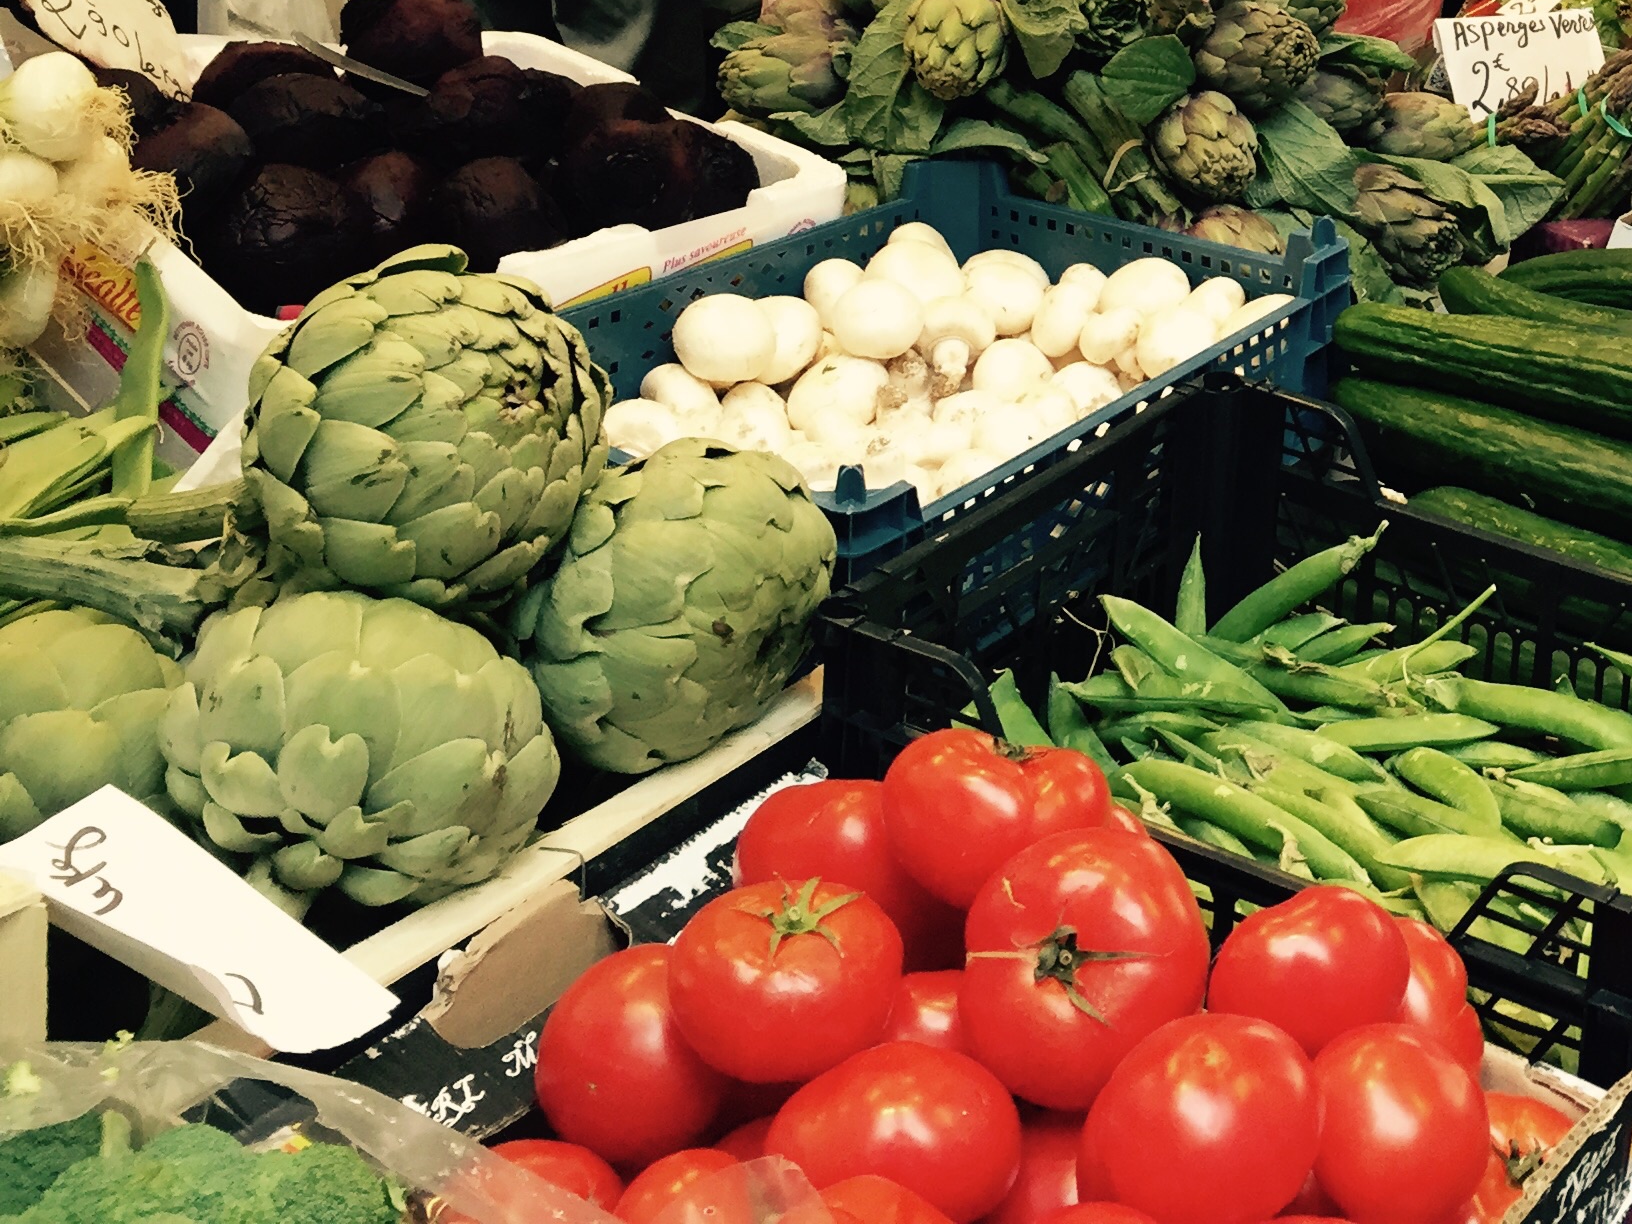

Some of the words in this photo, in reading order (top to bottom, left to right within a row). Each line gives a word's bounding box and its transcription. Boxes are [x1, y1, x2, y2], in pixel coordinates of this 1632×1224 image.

[1452, 18, 1547, 52] Asperges
[1549, 13, 1597, 40] Vertes
[662, 253, 687, 274] Plus
[688, 226, 748, 262] savoureuse
